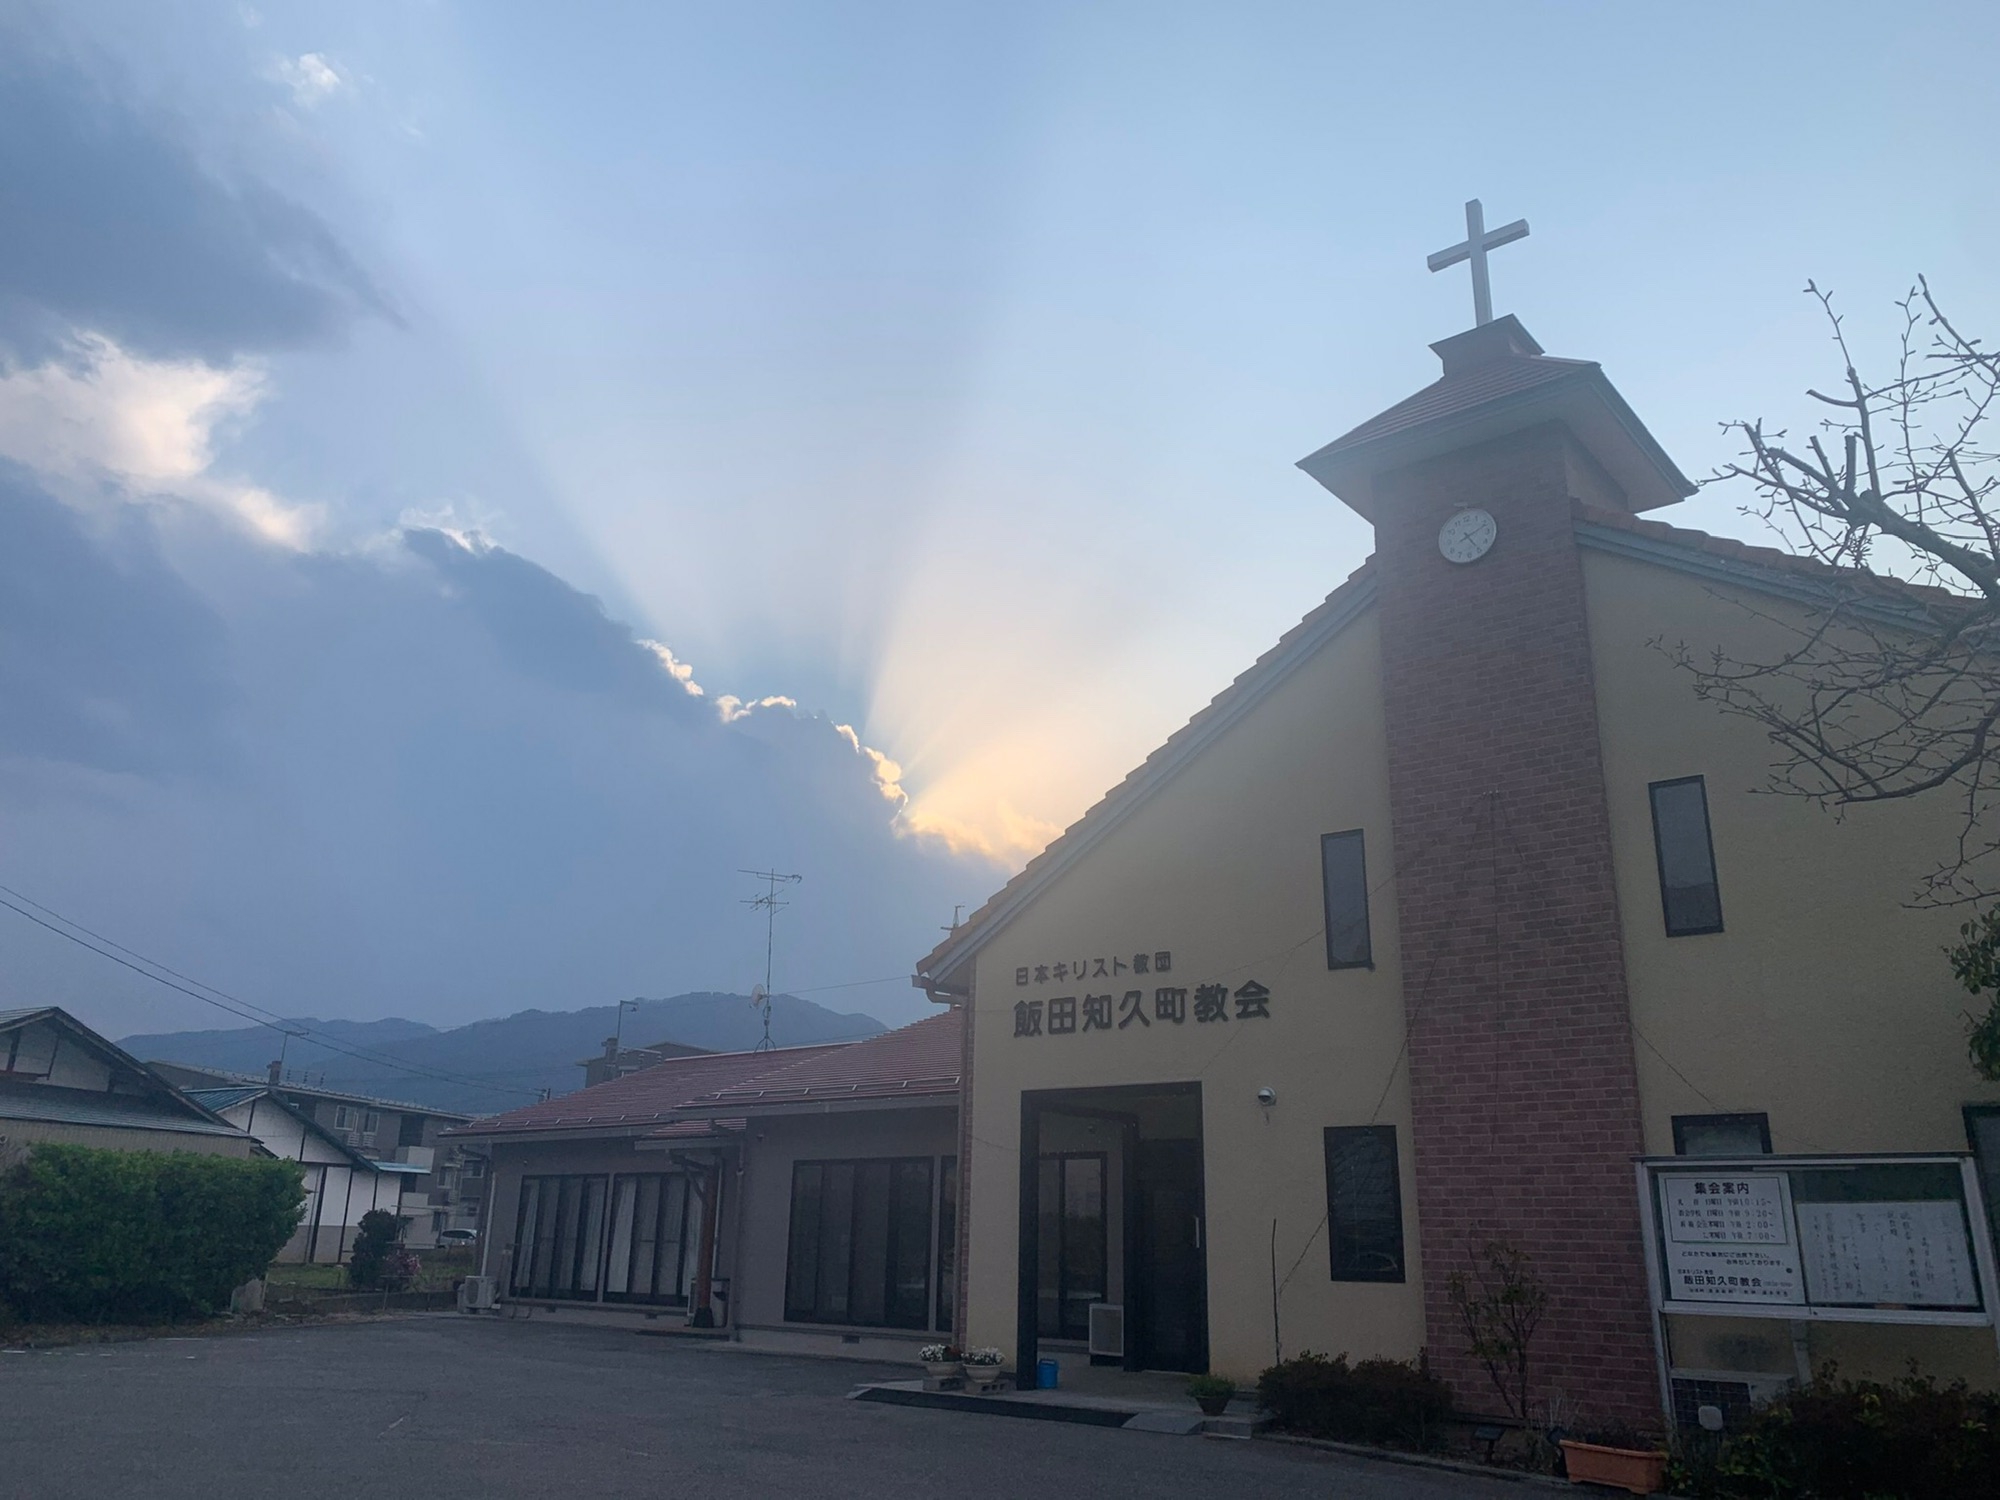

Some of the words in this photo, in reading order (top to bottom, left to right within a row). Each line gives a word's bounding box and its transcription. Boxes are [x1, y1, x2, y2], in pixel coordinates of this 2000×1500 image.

[1016, 951, 1171, 986] 日本キリスト教団
[1013, 979, 1270, 1038] 飯田知久町教会
[1694, 1182, 1749, 1195] 集会案内
[1684, 1275, 1762, 1287] 飯田知久町教会
